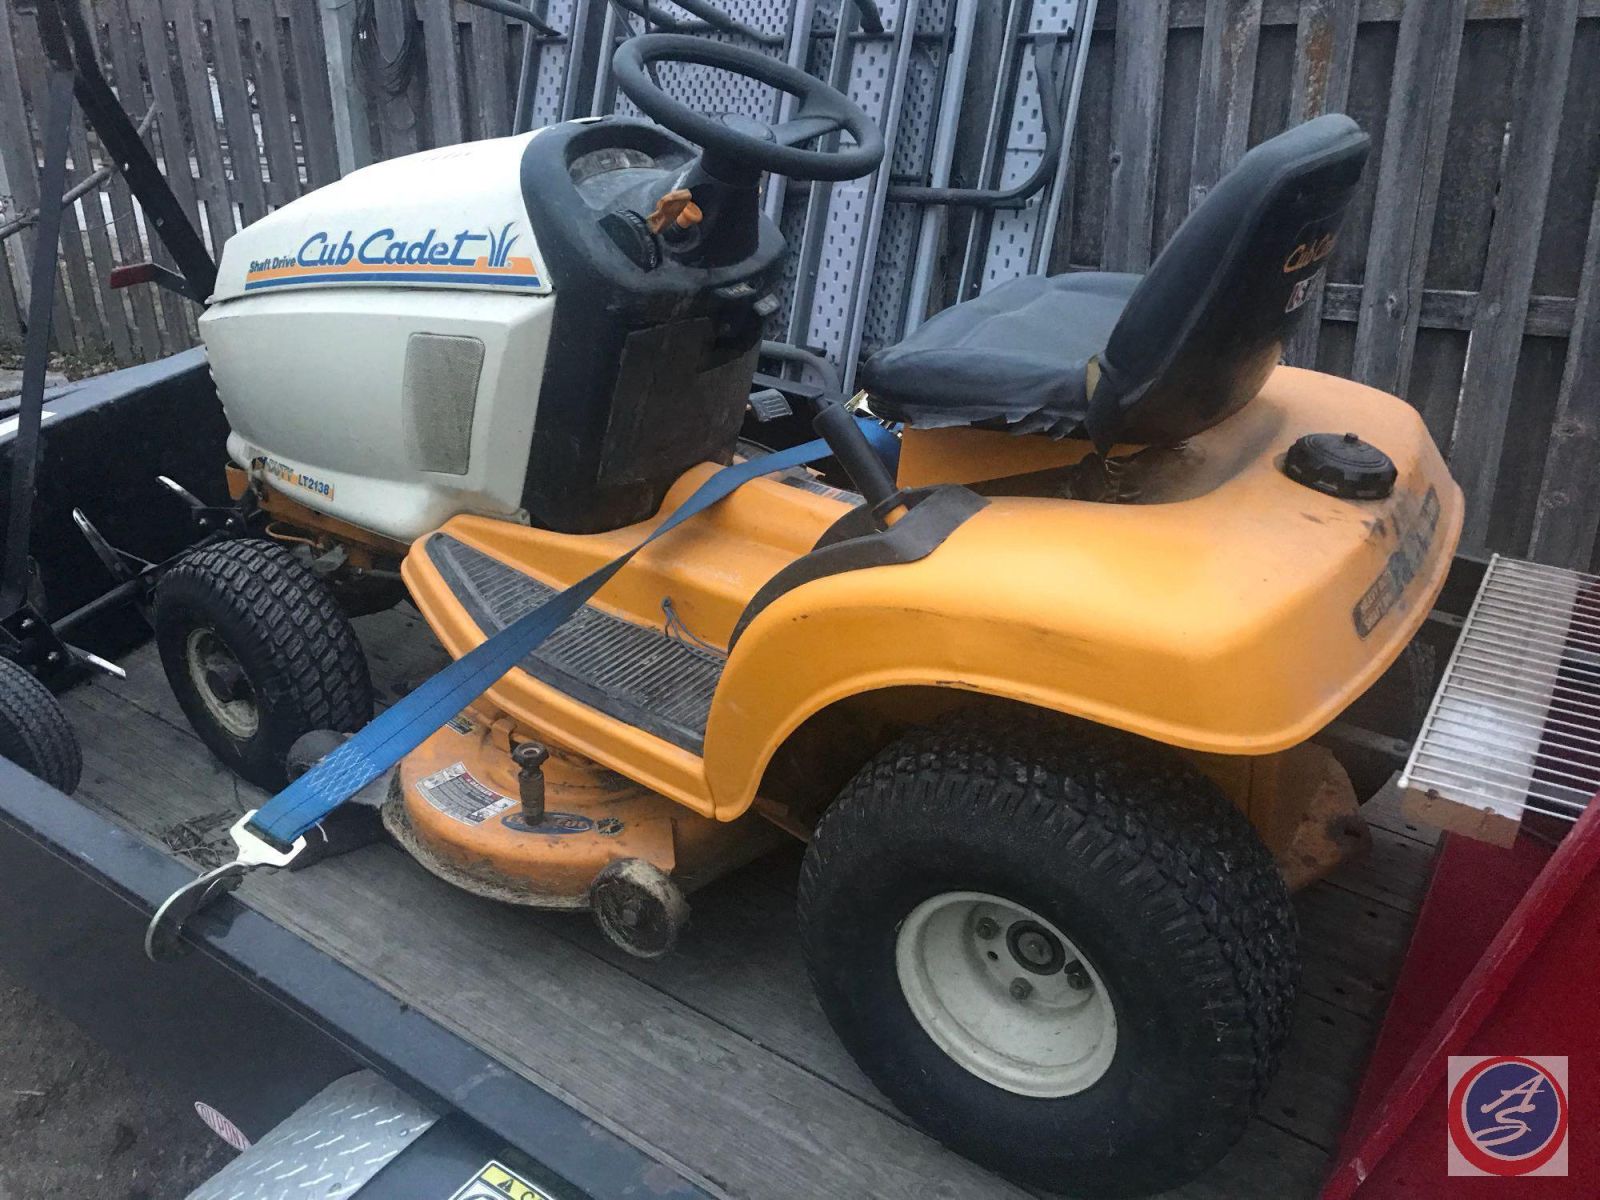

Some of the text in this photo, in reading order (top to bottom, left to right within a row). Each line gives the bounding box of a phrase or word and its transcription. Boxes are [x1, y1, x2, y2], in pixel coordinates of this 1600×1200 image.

[249, 228, 488, 273] Shaft Drive Cub Cadet
